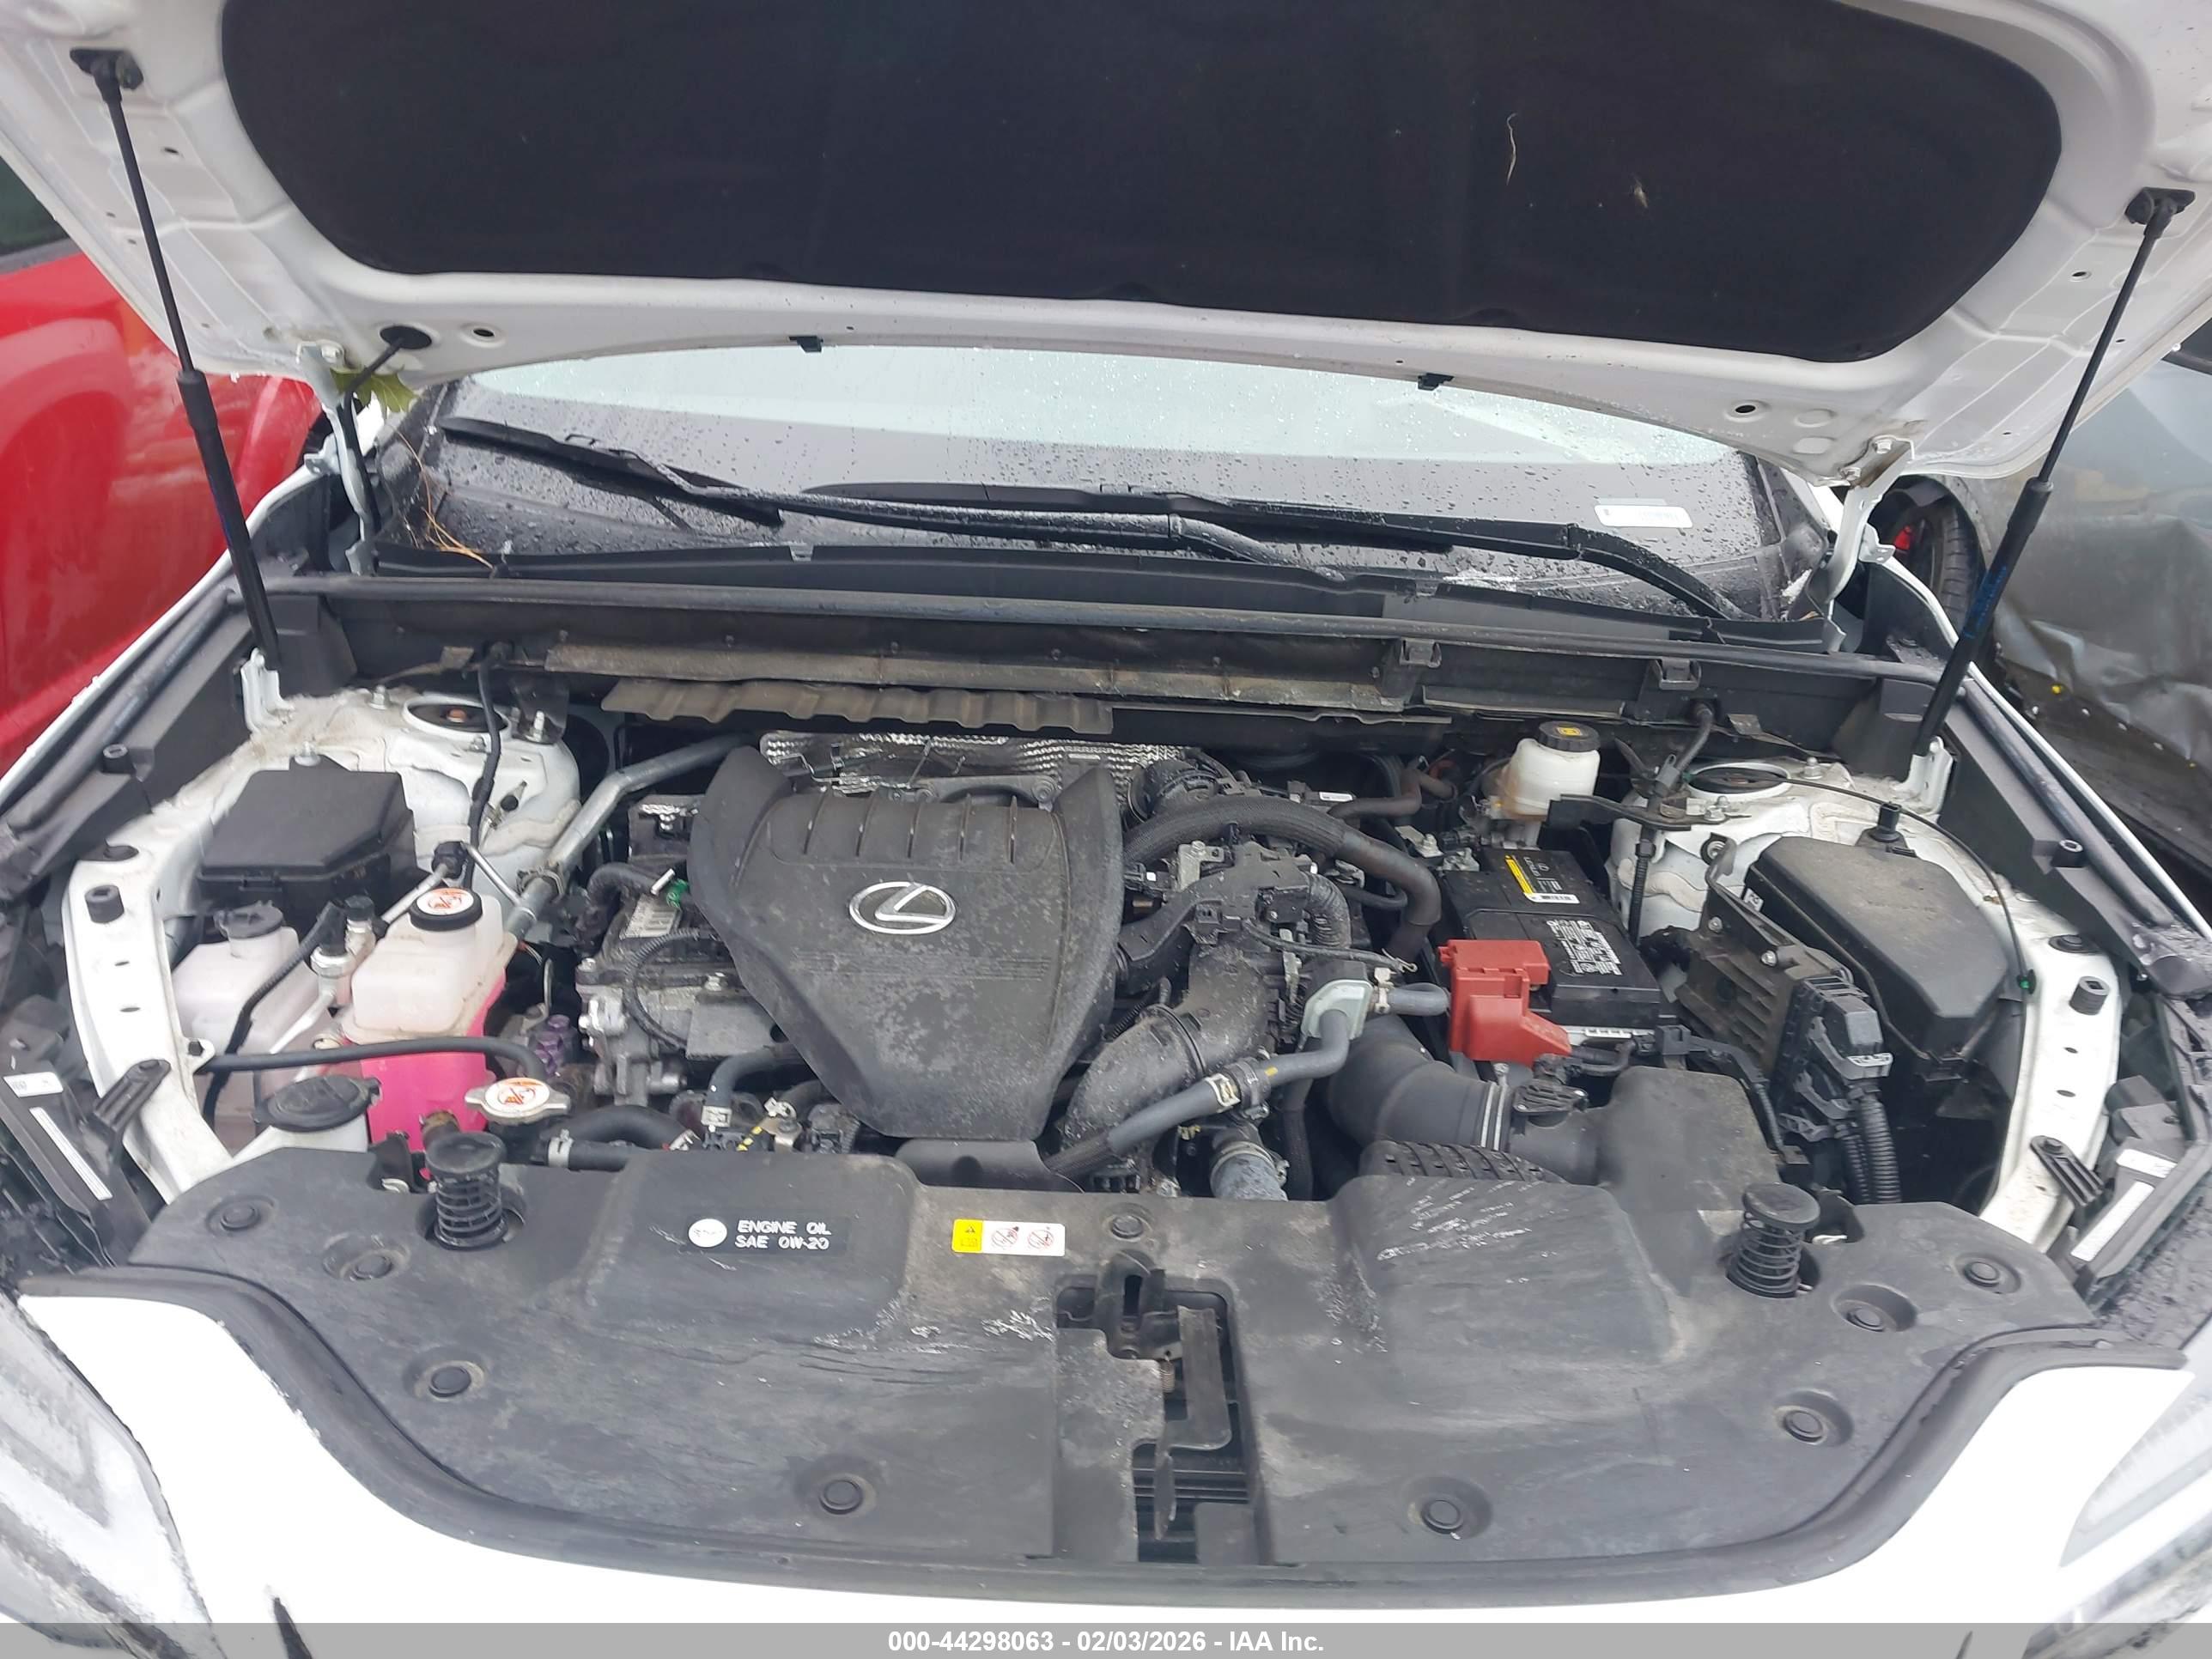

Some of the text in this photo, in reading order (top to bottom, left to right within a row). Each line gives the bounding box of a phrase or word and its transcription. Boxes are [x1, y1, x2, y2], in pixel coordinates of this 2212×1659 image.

[737, 1219, 798, 1235] ENGINE
[805, 1221, 832, 1236] OIL
[735, 1235, 770, 1249] SAE
